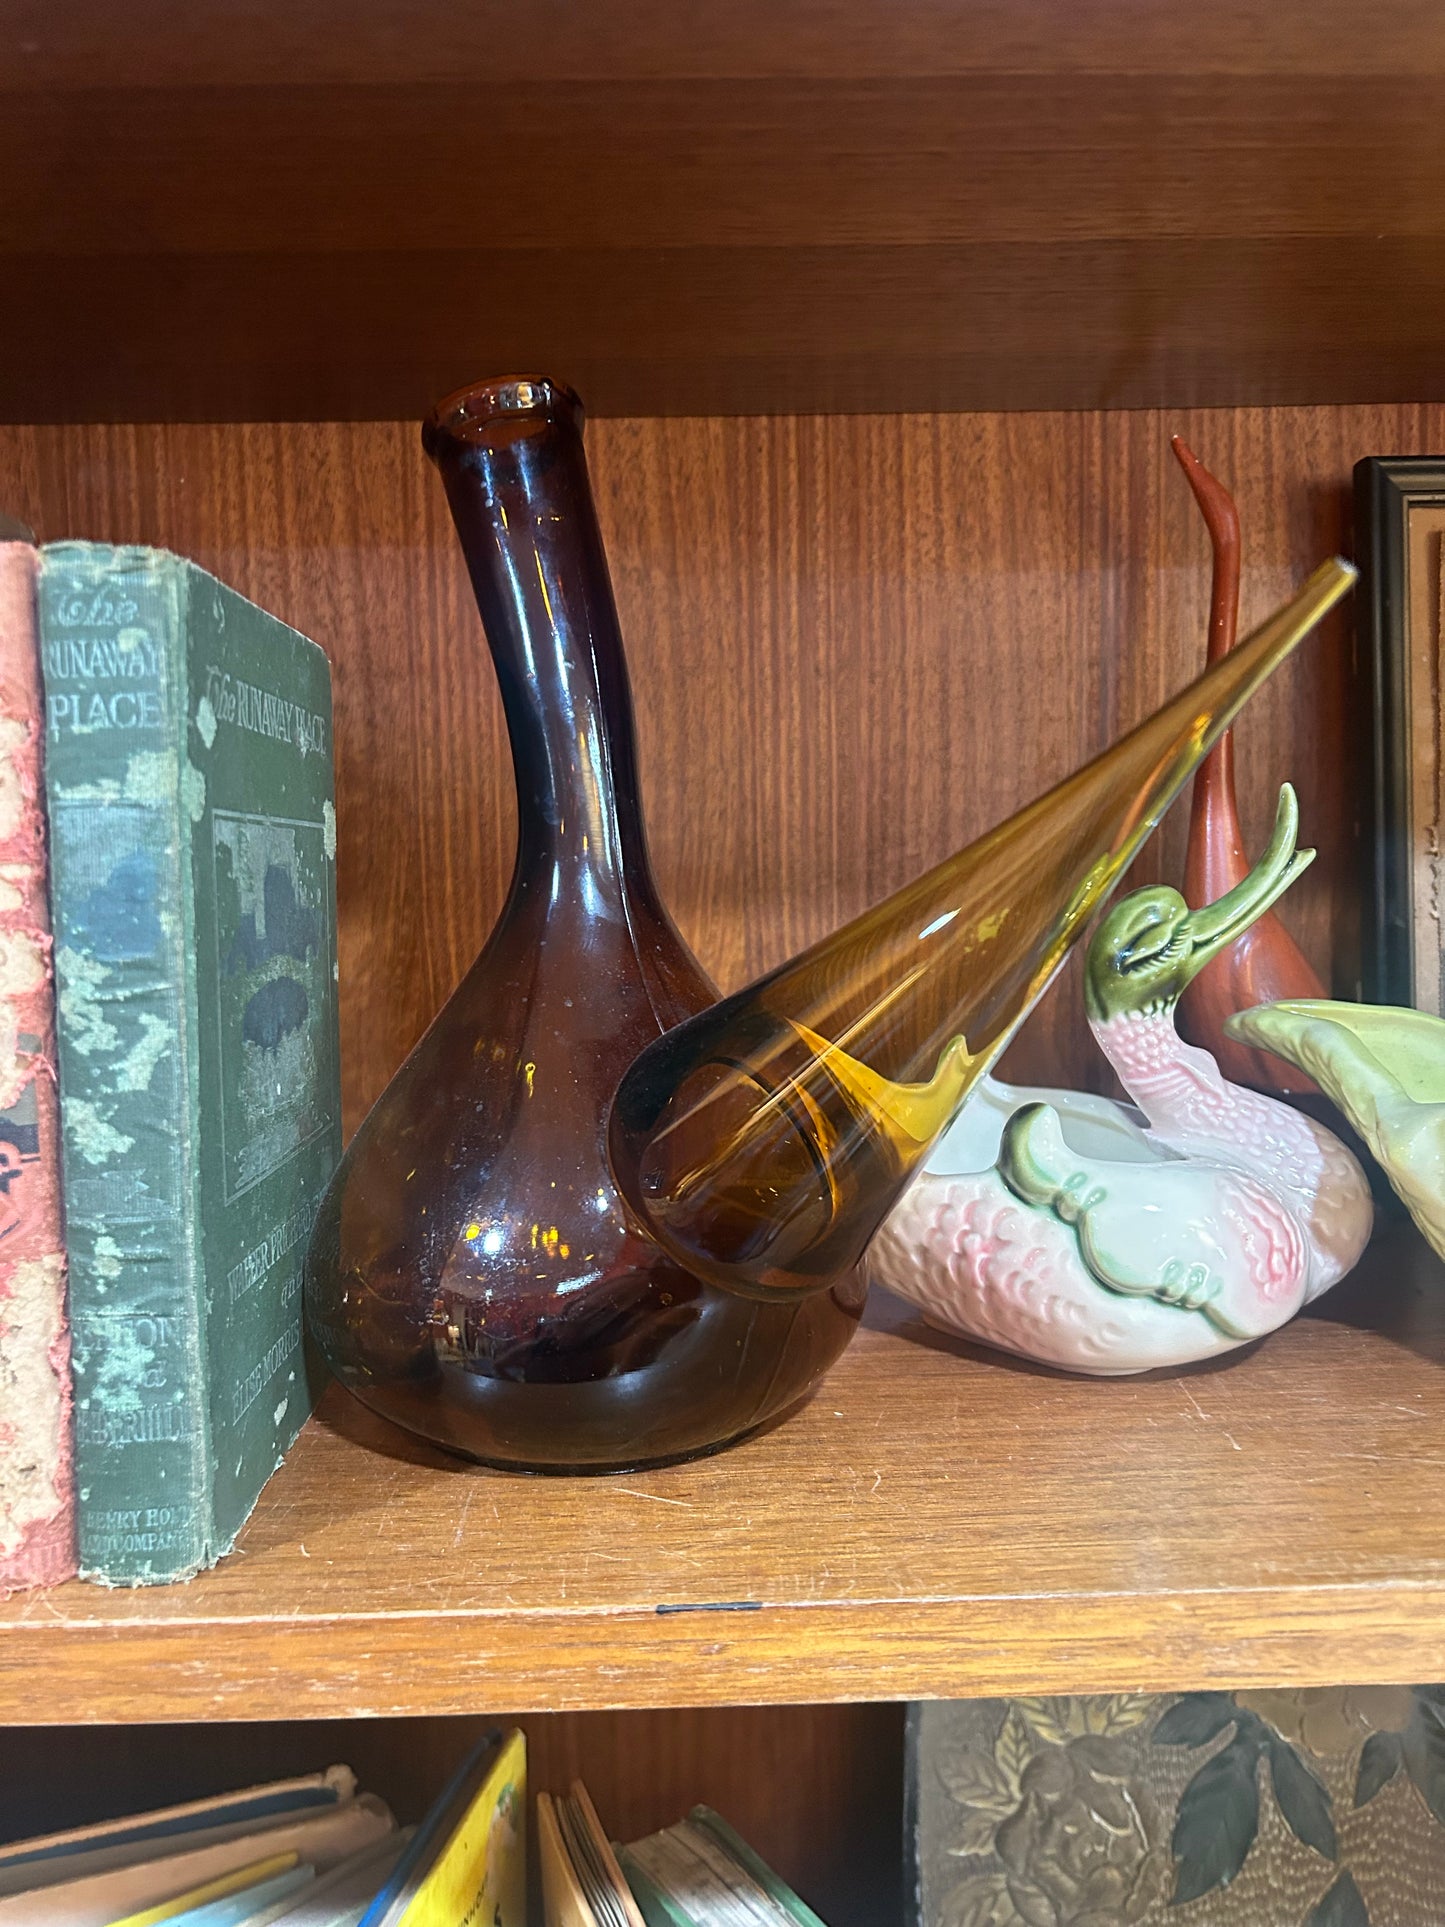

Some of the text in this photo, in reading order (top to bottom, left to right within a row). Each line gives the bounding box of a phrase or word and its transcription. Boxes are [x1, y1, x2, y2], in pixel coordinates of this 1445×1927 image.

[48, 690, 160, 731] PLACE
[204, 663, 328, 757] The RUNAWAY PLACE
[231, 1318, 301, 1427] ELISE MORRIS
